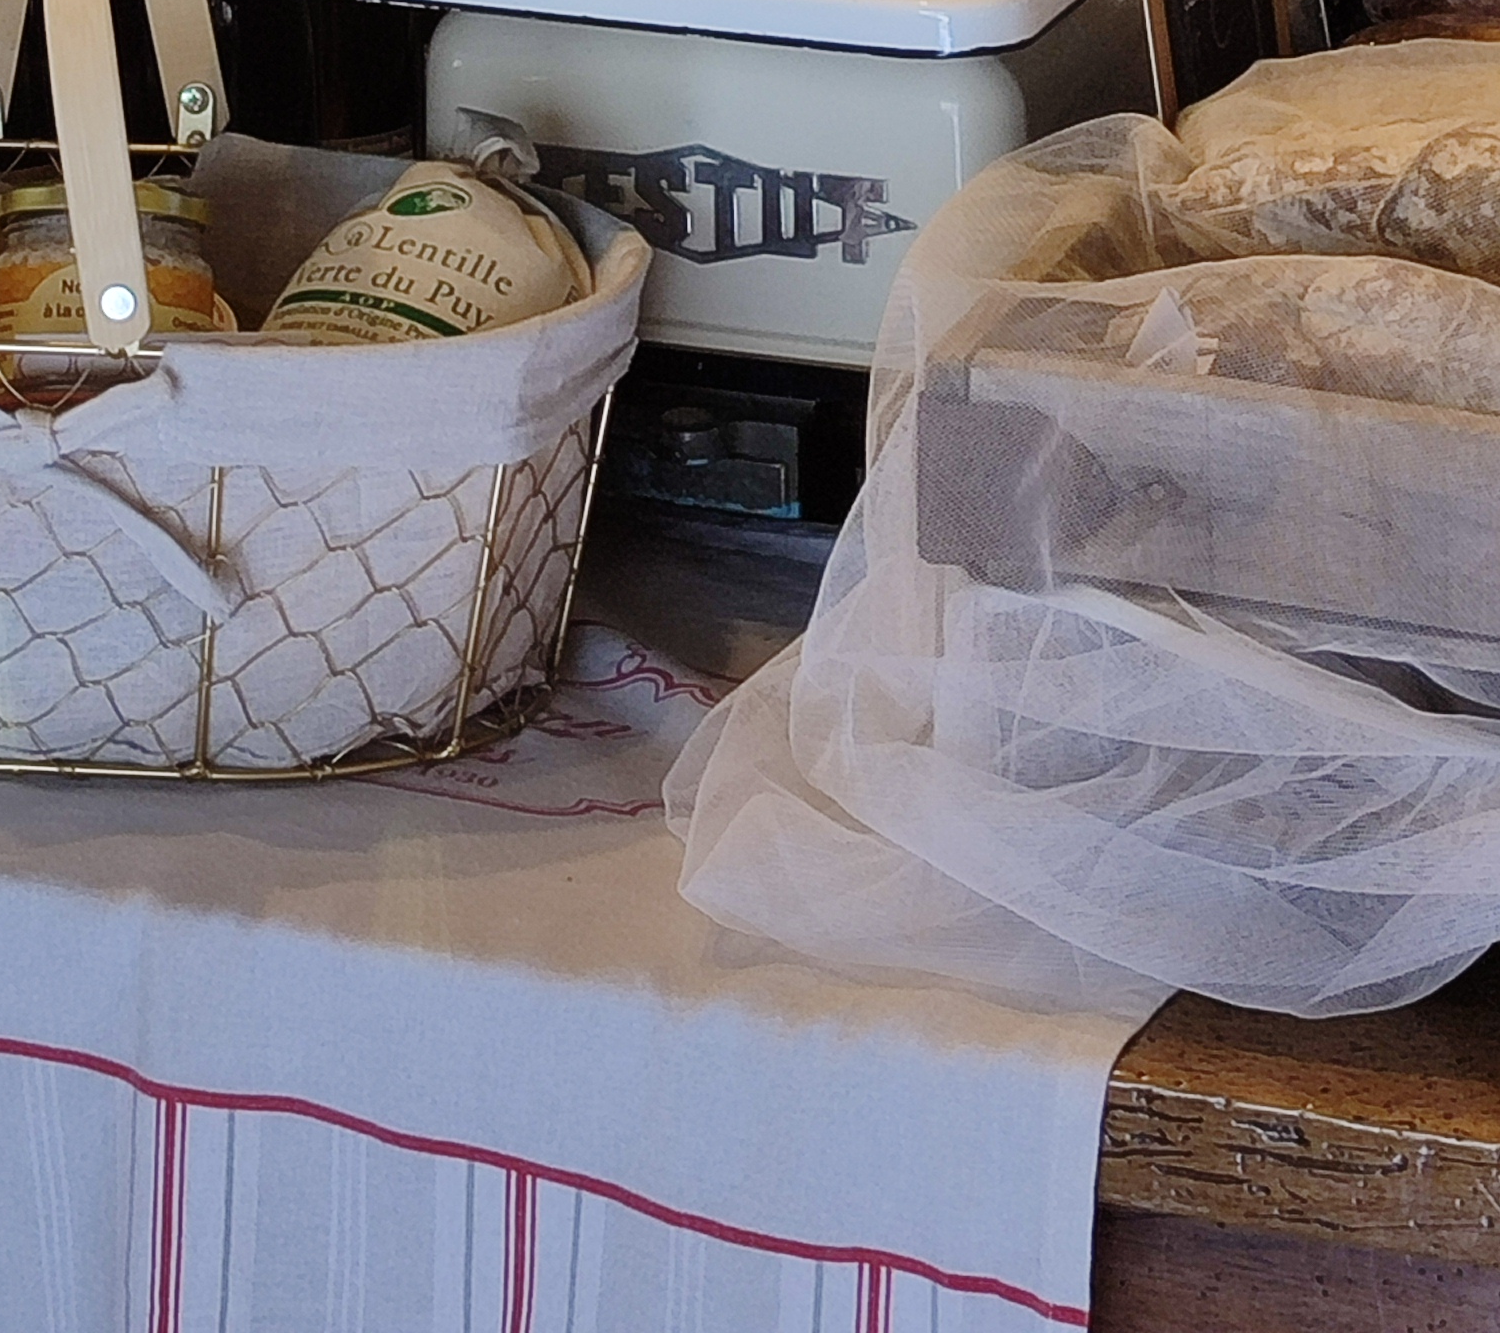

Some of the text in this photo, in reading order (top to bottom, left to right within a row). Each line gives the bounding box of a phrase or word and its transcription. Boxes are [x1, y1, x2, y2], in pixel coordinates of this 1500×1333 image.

[534, 143, 889, 265] ESTUT
[372, 225, 514, 297] Lentille
[56, 305, 72, 318] la
[371, 267, 414, 296] du
[425, 279, 494, 331] Puy
